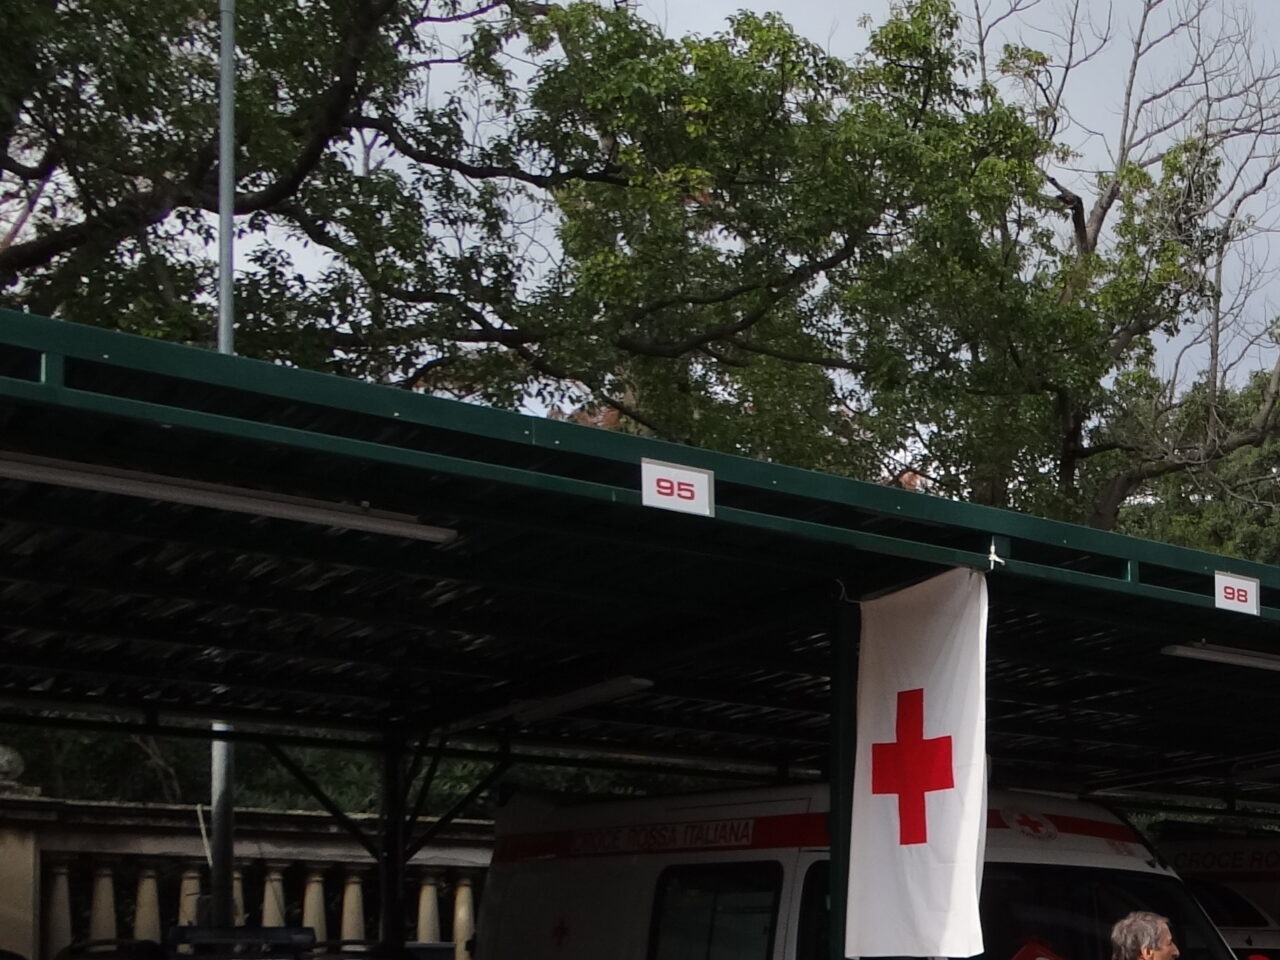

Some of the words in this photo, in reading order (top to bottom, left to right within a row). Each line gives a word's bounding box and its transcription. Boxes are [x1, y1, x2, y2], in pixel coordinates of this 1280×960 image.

[656, 478, 695, 500] 95
[1224, 586, 1248, 603] 98
[683, 820, 752, 845] ITALIANA
[1174, 851, 1244, 869] CROCE
